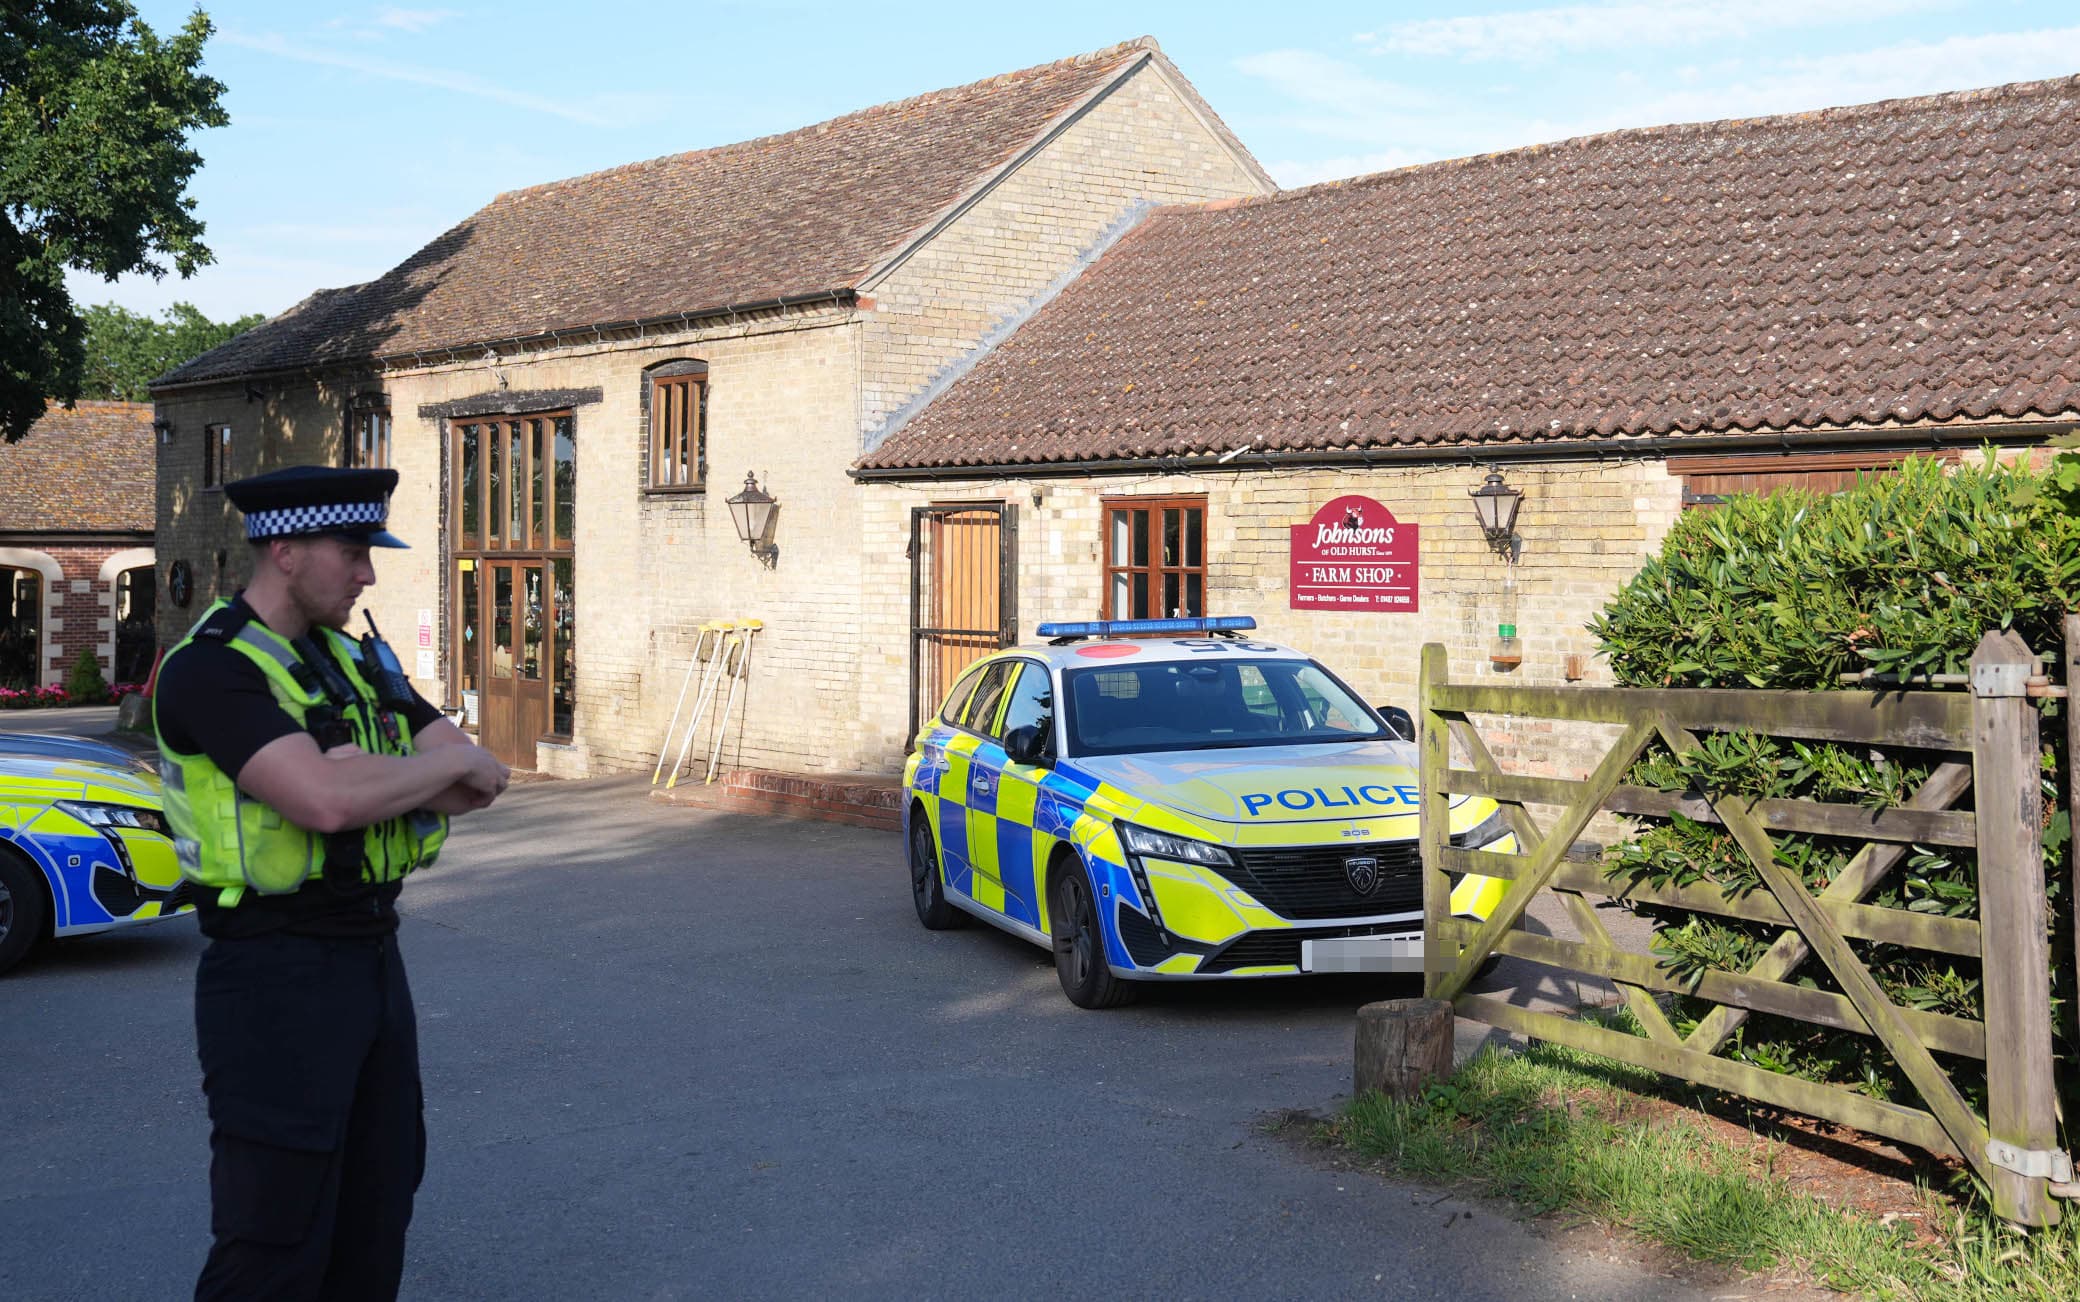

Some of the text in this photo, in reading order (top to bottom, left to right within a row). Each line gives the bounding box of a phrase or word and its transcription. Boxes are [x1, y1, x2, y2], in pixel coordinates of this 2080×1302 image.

[1312, 522, 1394, 548] Johnsons
[1330, 547, 1347, 556] OLD
[1349, 547, 1376, 556] HURST
[1312, 567, 1394, 583] FARM SHOP
[1240, 785, 1420, 816] POLICE
